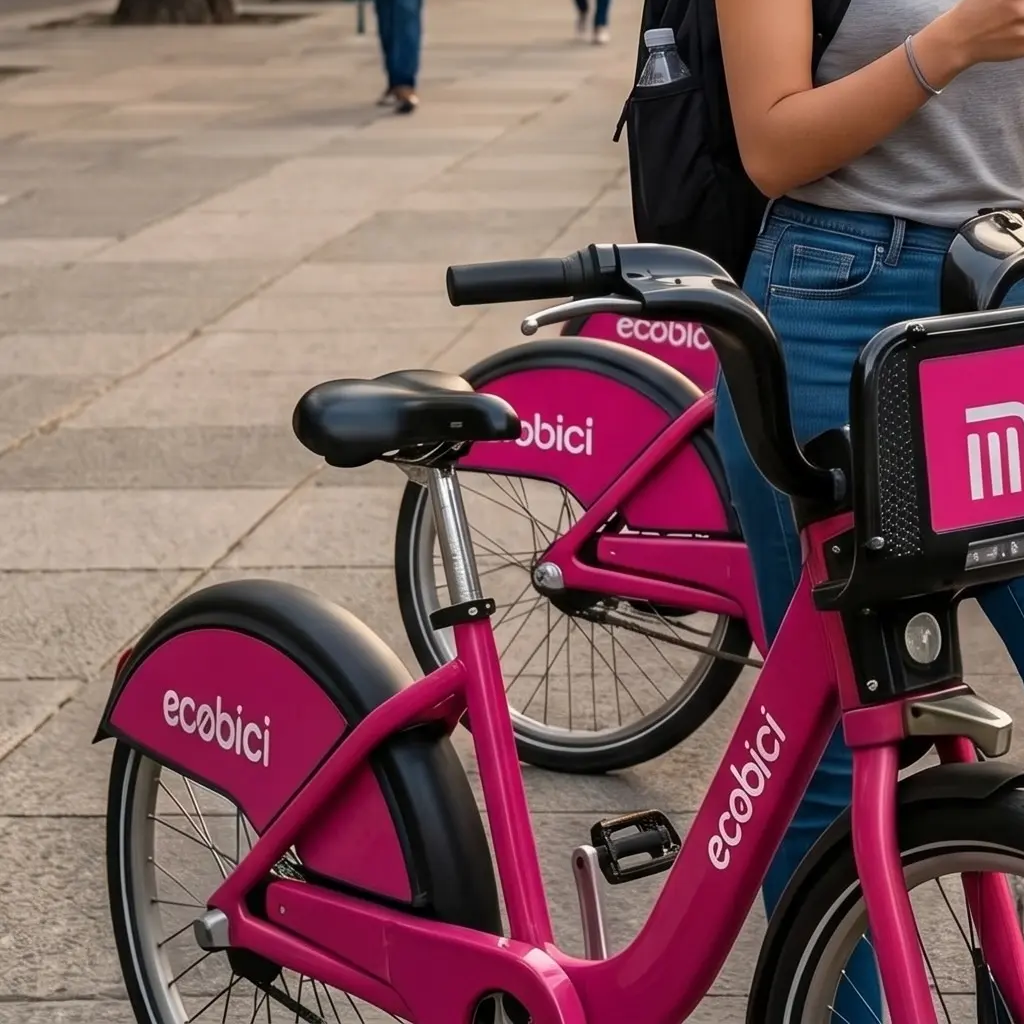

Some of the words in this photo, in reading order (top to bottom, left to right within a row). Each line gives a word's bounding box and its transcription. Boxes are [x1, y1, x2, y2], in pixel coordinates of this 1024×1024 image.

[616, 317, 712, 350] ecobic
[514, 412, 594, 456] obici
[708, 705, 786, 869] ecobici
